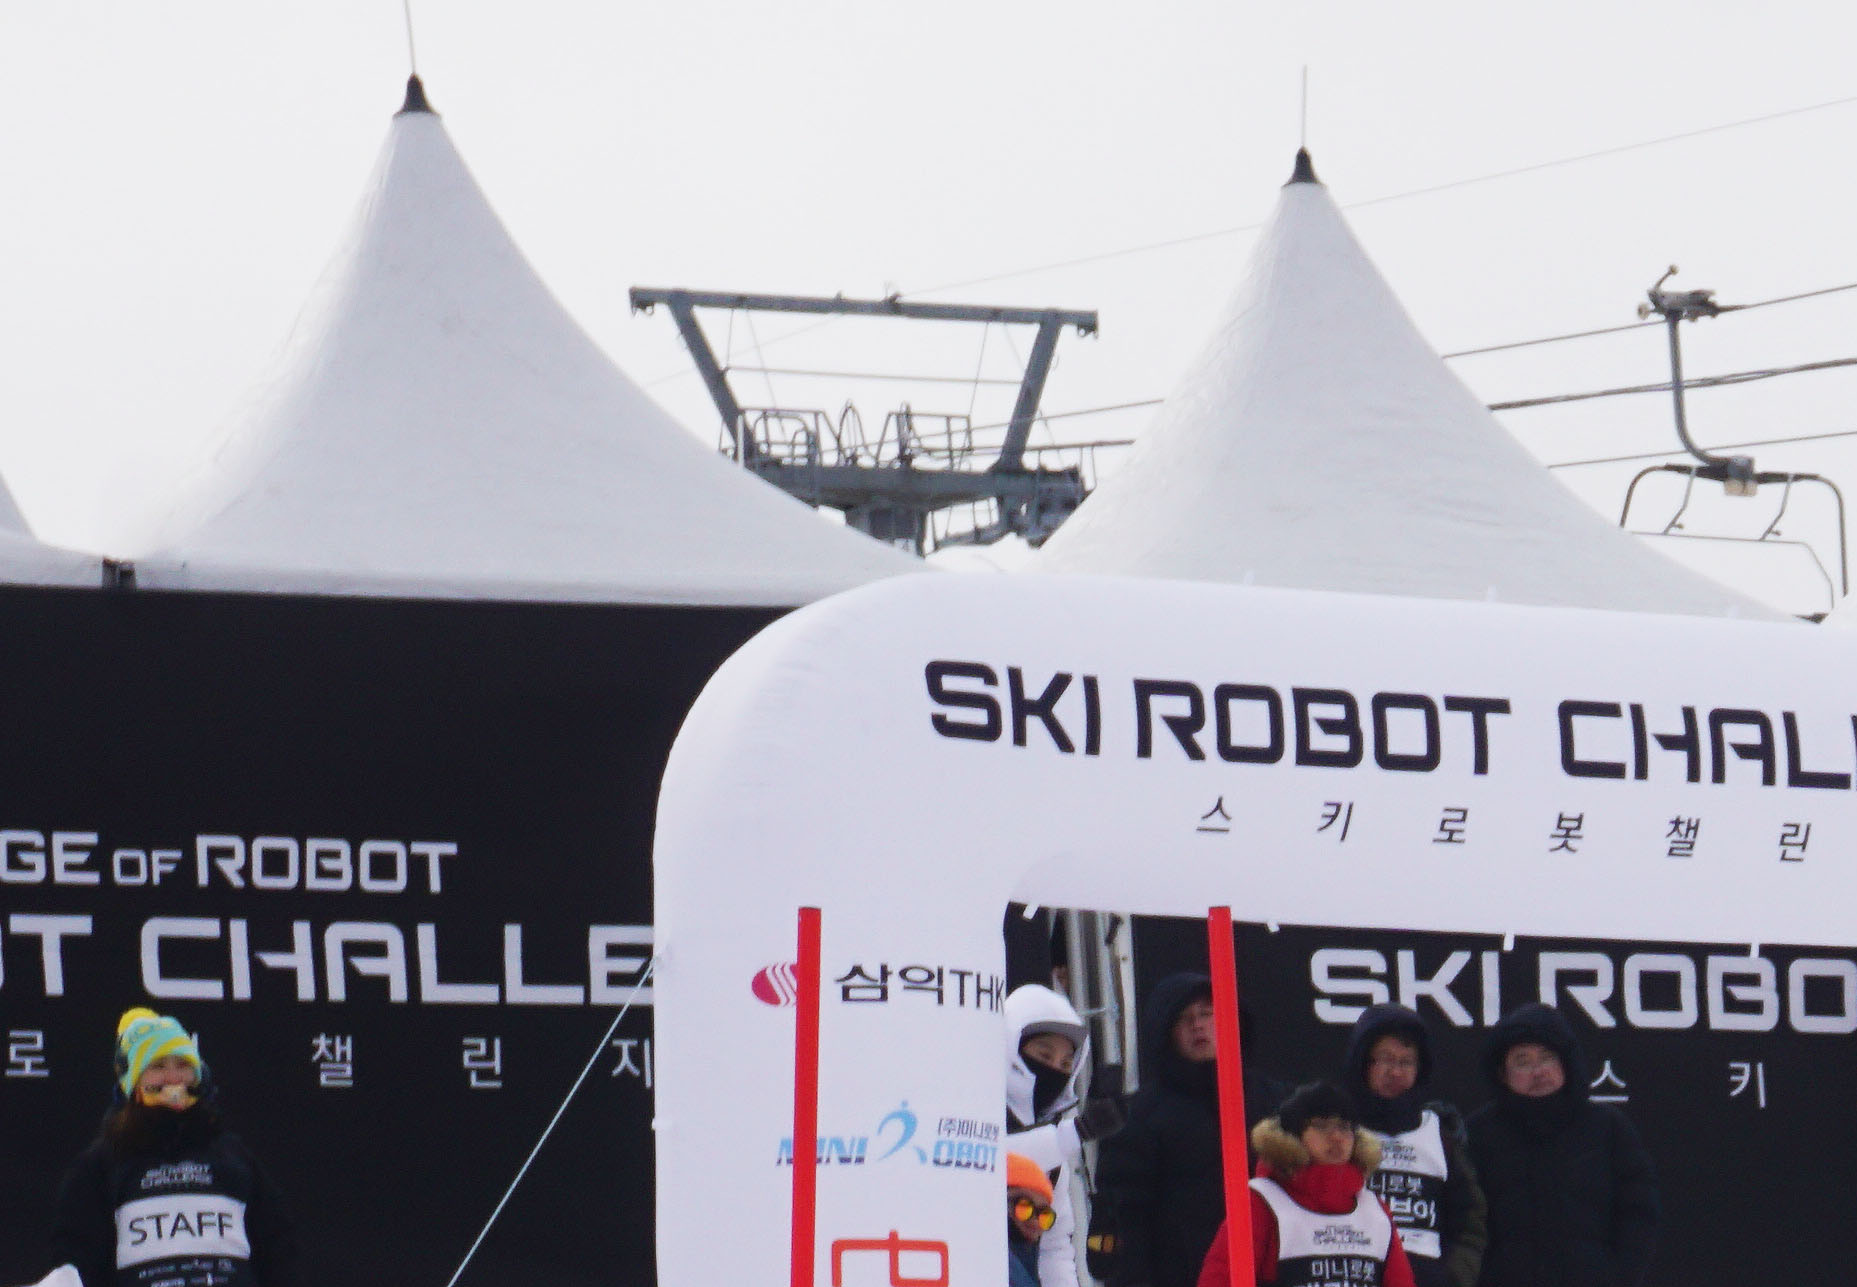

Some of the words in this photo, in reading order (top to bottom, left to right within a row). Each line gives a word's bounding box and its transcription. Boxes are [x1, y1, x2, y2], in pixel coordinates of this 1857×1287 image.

[924, 660, 1101, 756] SKI
[1134, 678, 1511, 776] ROBOT
[0, 830, 100, 884] GE
[112, 849, 182, 885] OF
[195, 834, 458, 893] ROBOT
[0, 913, 93, 996] T
[141, 916, 653, 1005] CHALLE
[1310, 948, 1501, 1027] SKI
[129, 1211, 233, 1246] STAFF
[1381, 1194, 1436, 1228] 브이
